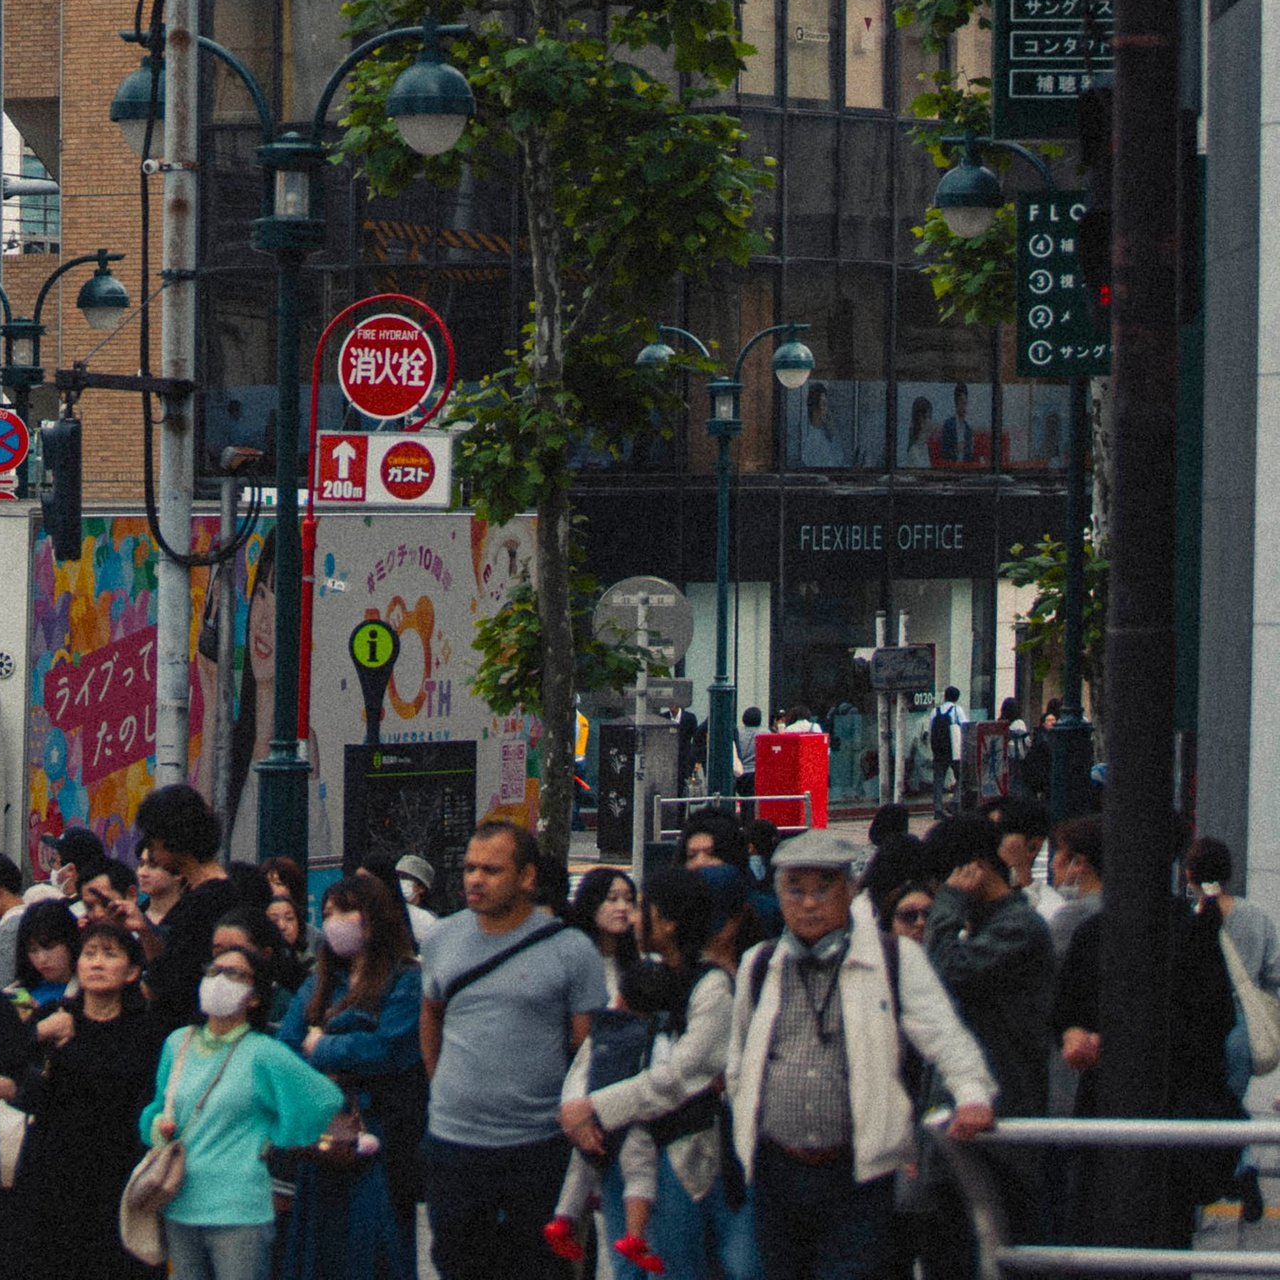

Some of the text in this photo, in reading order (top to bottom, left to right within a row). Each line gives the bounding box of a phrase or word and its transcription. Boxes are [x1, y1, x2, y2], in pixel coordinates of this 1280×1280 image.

[357, 329, 419, 341] FIRE HYDRANT
[348, 346, 428, 386] 消火栓
[387, 466, 430, 483] ガスト
[322, 480, 363, 499] 200m
[800, 524, 964, 551] FLEXIBLE OFFICE
[55, 640, 154, 721] ライブって
